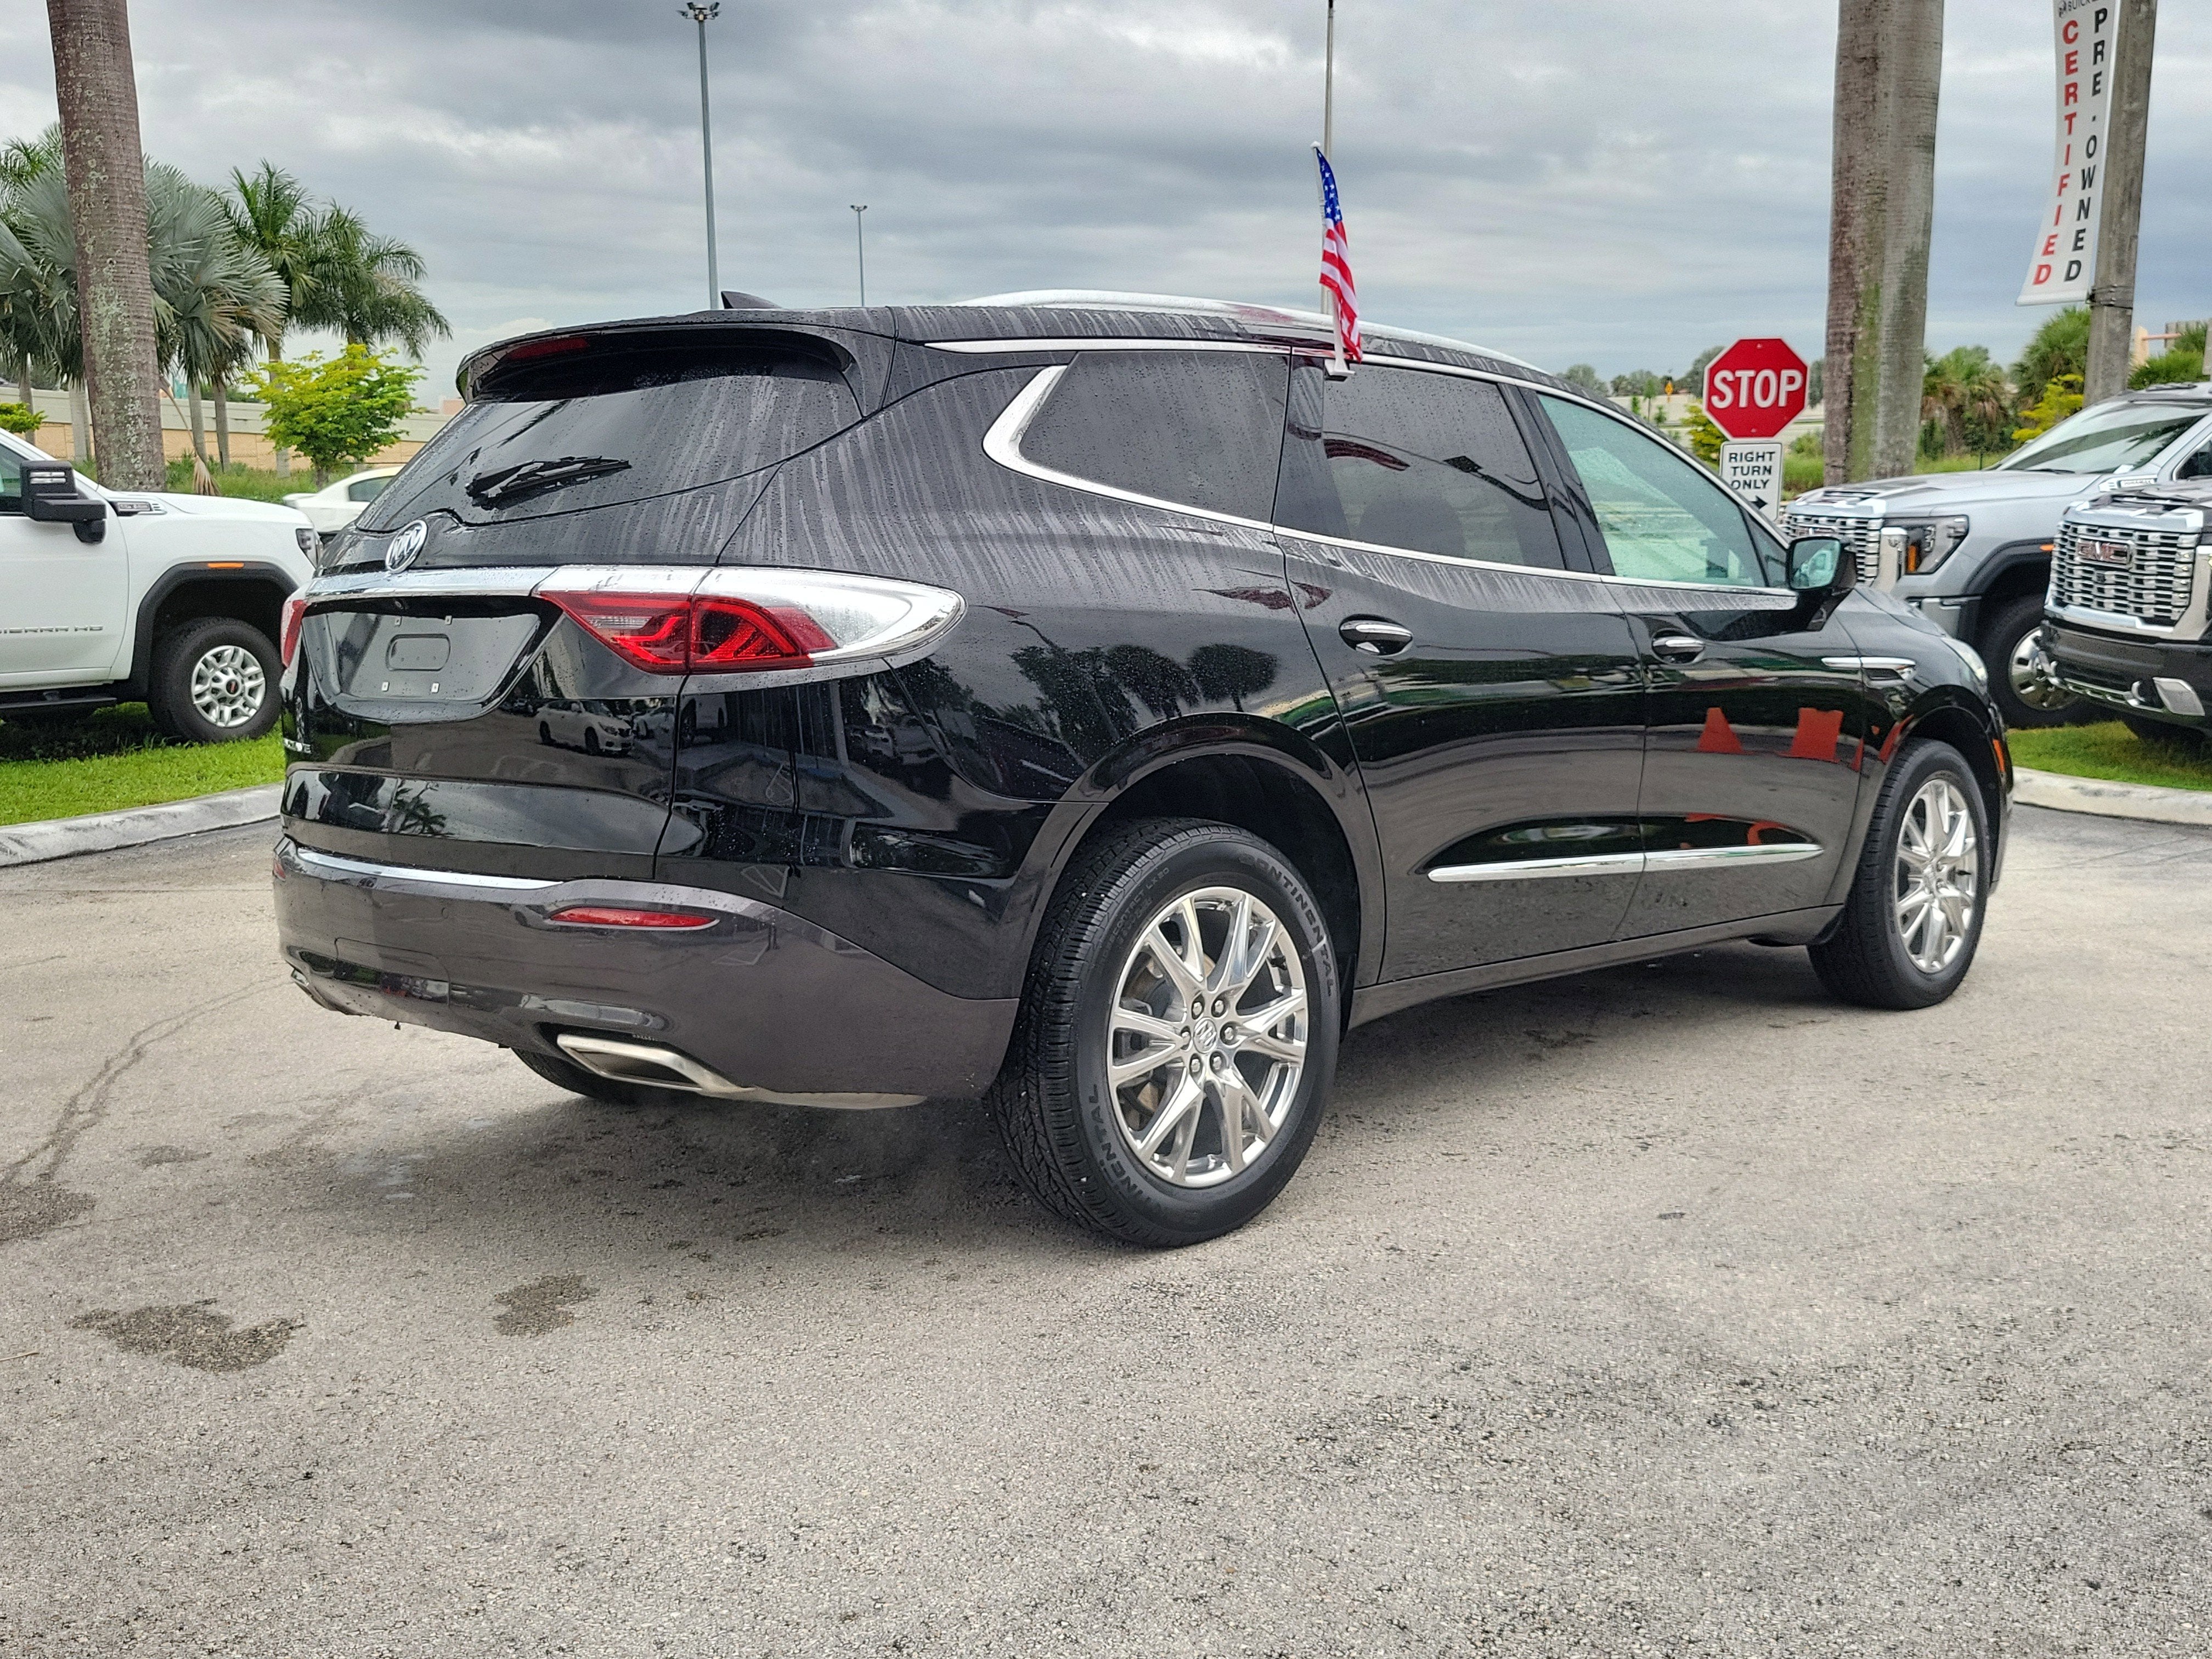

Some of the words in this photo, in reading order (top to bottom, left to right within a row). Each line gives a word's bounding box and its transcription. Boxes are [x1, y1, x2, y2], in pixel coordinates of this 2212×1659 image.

[2068, 0, 2090, 11] BUIC
[2033, 20, 2079, 286] CERTIFIED
[1711, 369, 1803, 408] STOP
[1729, 452, 1775, 462] RIGHT
[1731, 465, 1772, 476] TURN
[1731, 479, 1770, 489] ONLY
[2076, 539, 2128, 564] GMC
[0, 626, 69, 634] IERRA
